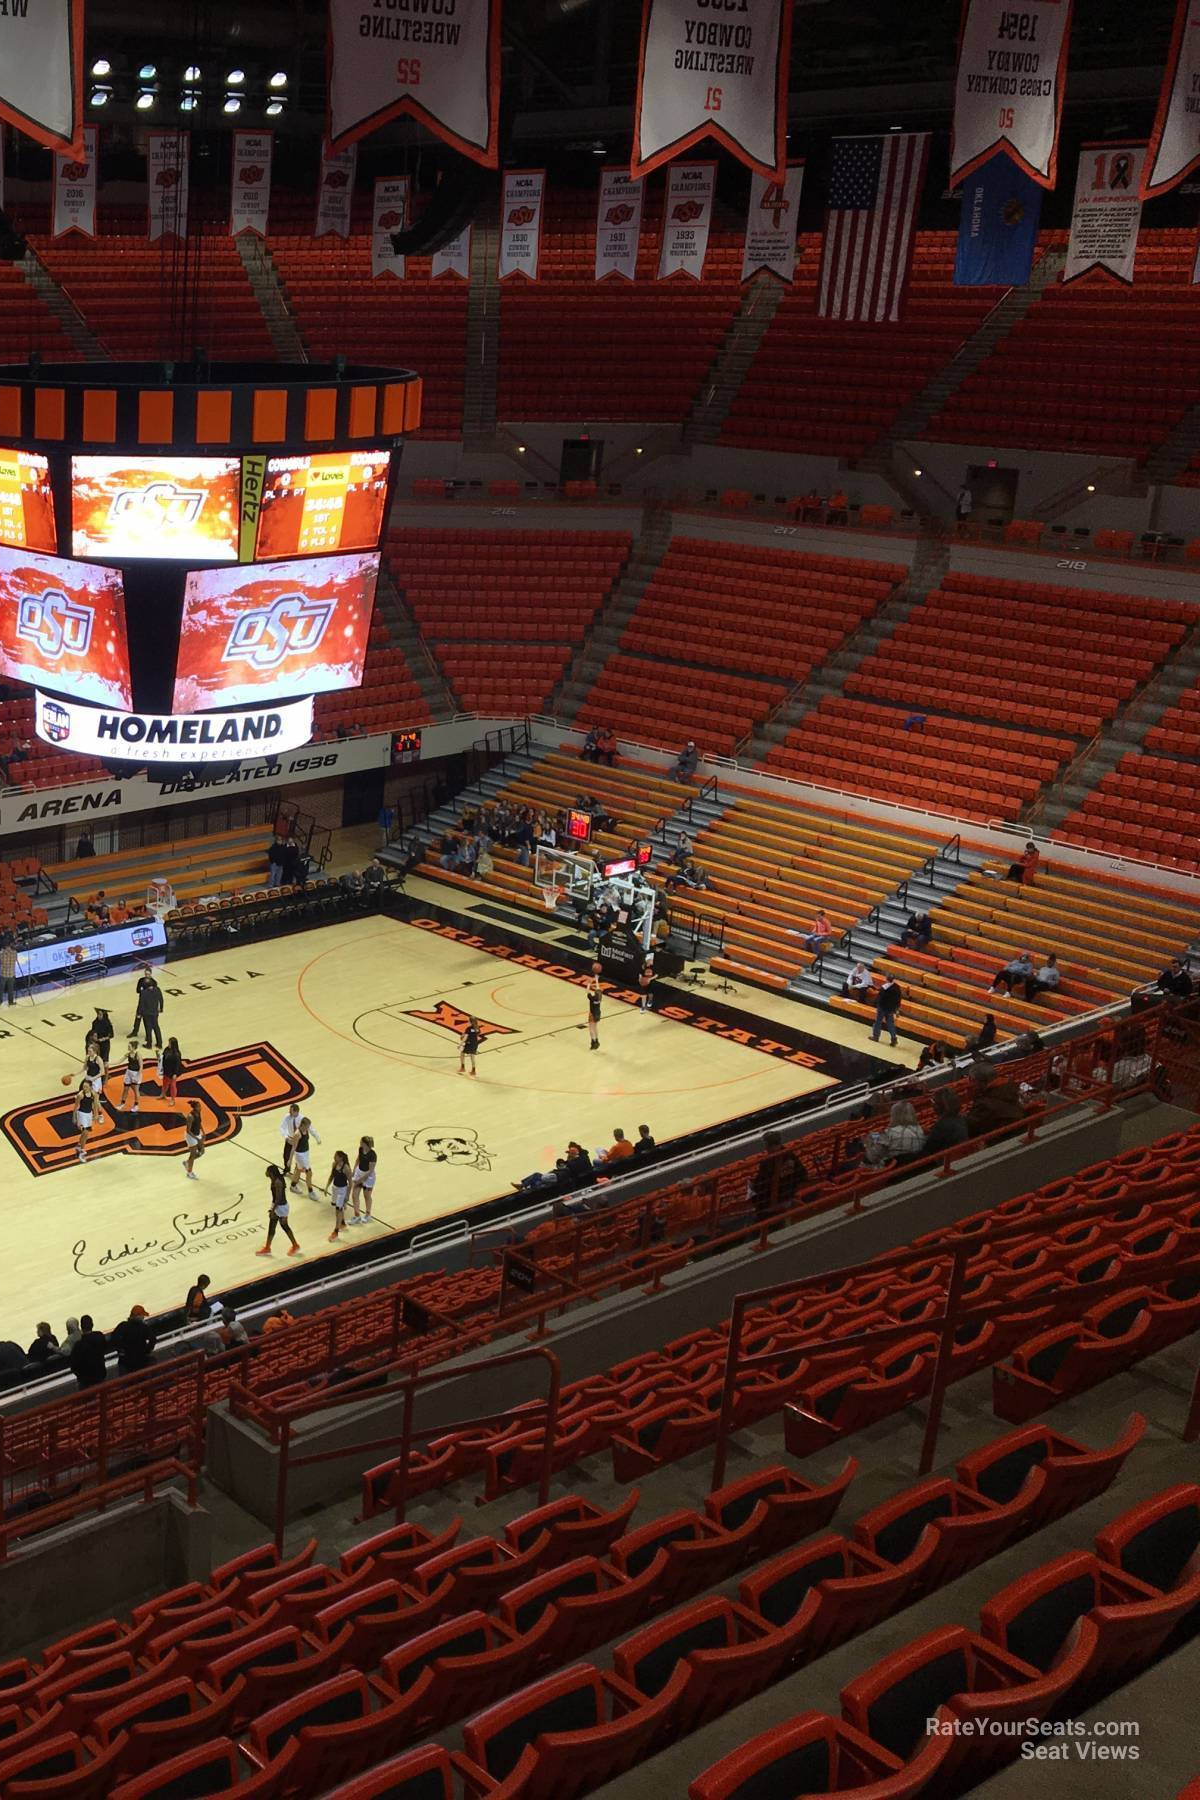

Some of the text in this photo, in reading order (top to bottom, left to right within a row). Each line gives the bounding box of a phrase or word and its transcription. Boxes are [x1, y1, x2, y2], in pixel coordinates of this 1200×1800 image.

[516, 179, 533, 187] NCAA
[681, 172, 702, 180] NCAA
[506, 189, 541, 198] CHAMPIONS
[508, 206, 536, 226] OSU
[605, 204, 635, 225] OSU
[671, 201, 704, 222] OSU
[970, 187, 984, 238] OKLAHOMA
[243, 460, 263, 524] Hertz
[1057, 560, 1088, 570] 218
[16, 588, 95, 660] OSU
[221, 592, 339, 670] OSU
[97, 713, 282, 744] HOMELAND
[17, 789, 122, 823] ARENA
[289, 754, 339, 773] 1938
[165, 969, 265, 998] RENA
[657, 1005, 828, 1068] STATE
[72, 1239, 158, 1278] Eddie
[93, 1223, 267, 1286] EDDIE SUTTON COURT
